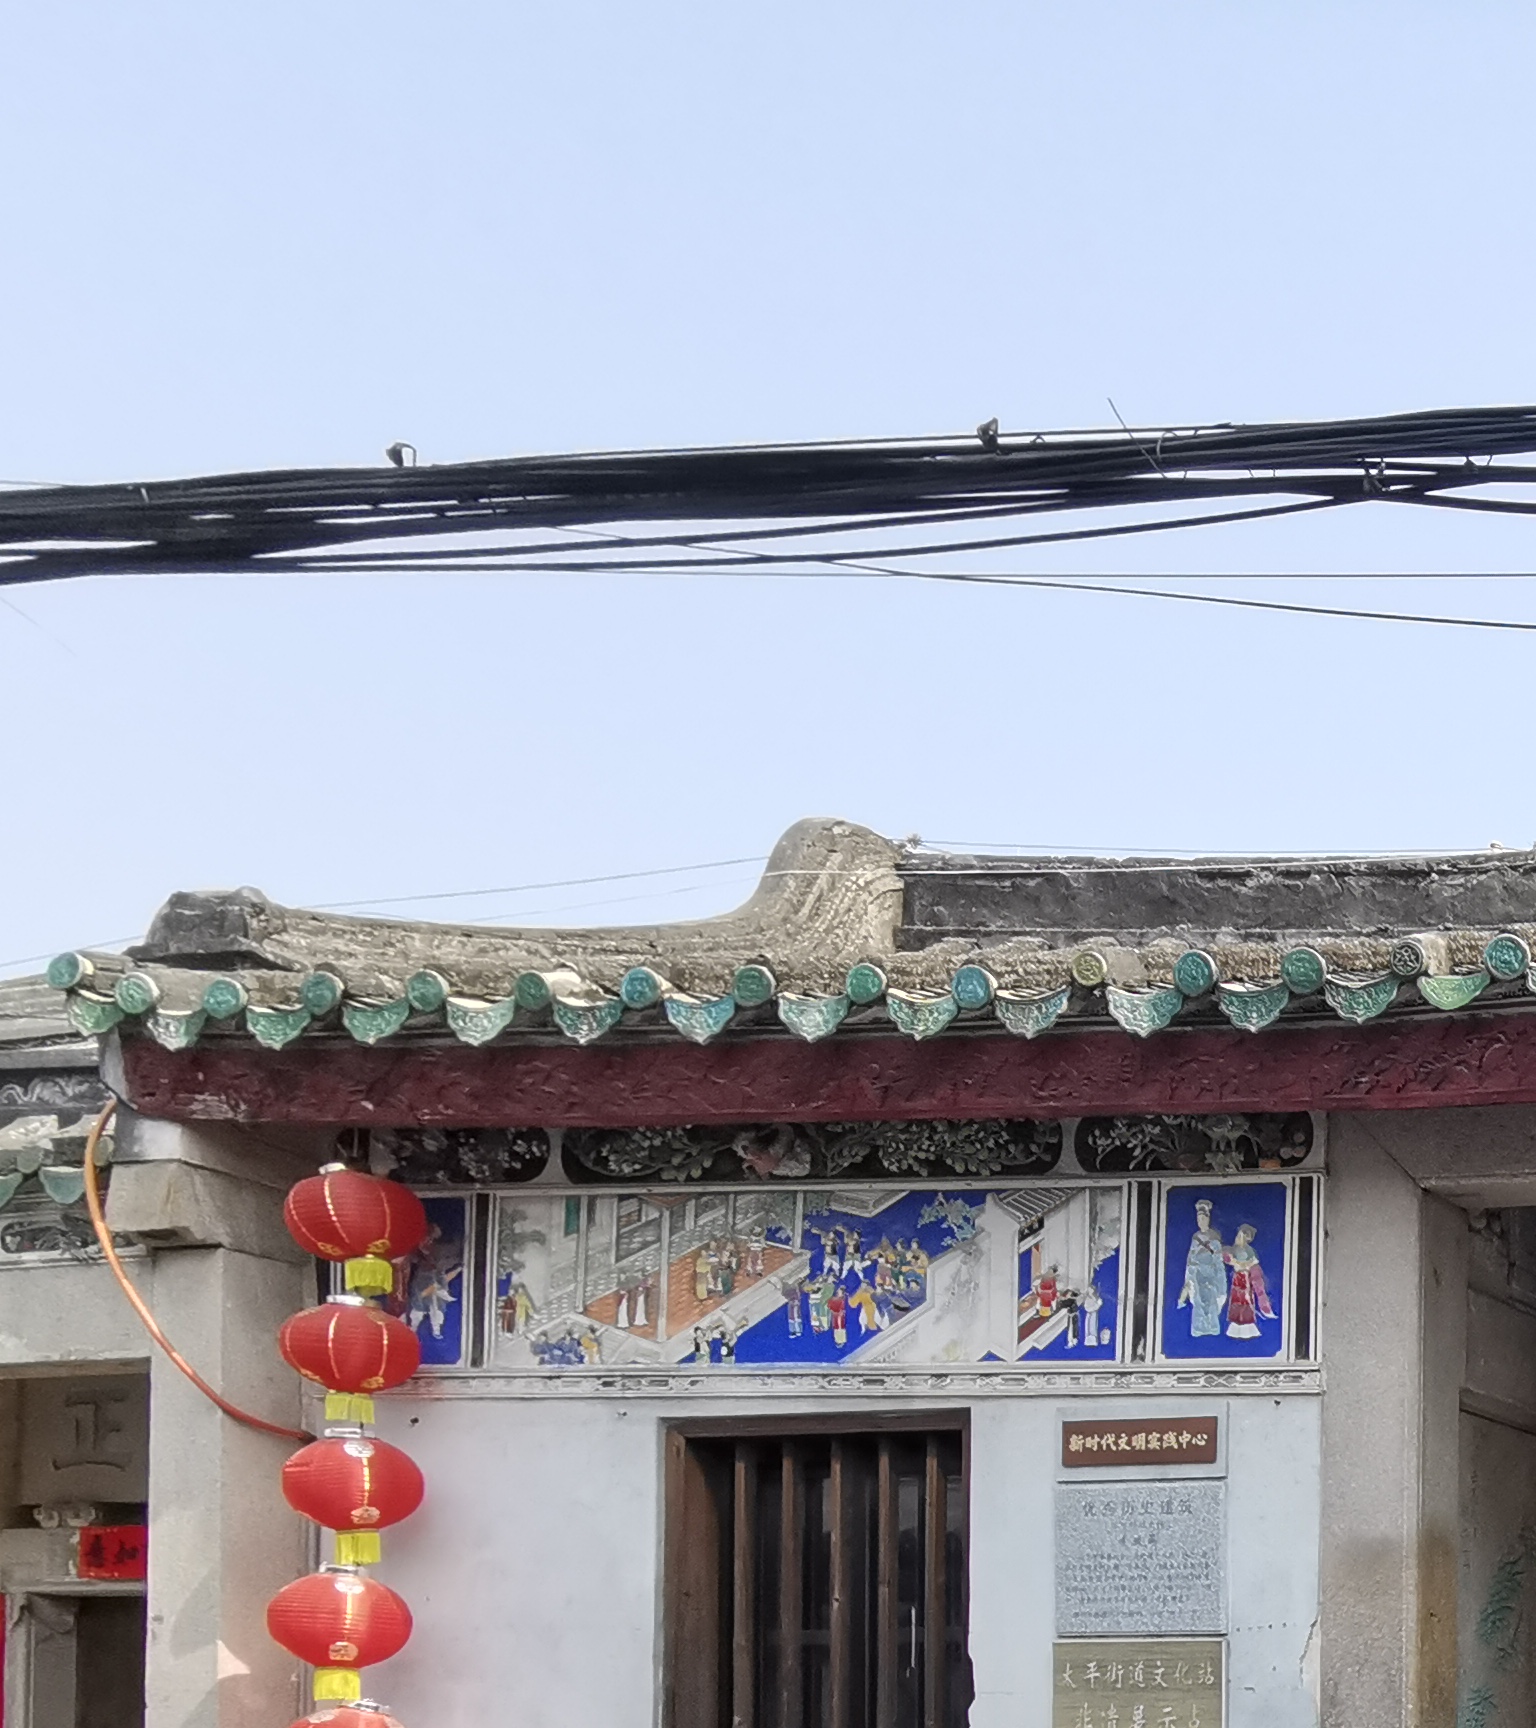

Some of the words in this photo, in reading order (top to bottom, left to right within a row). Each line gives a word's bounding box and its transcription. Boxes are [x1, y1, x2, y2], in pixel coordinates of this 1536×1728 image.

[1068, 1429, 1209, 1453] 新时代文明实践中心
[1062, 1659, 1216, 1689] 太平街道文化站
